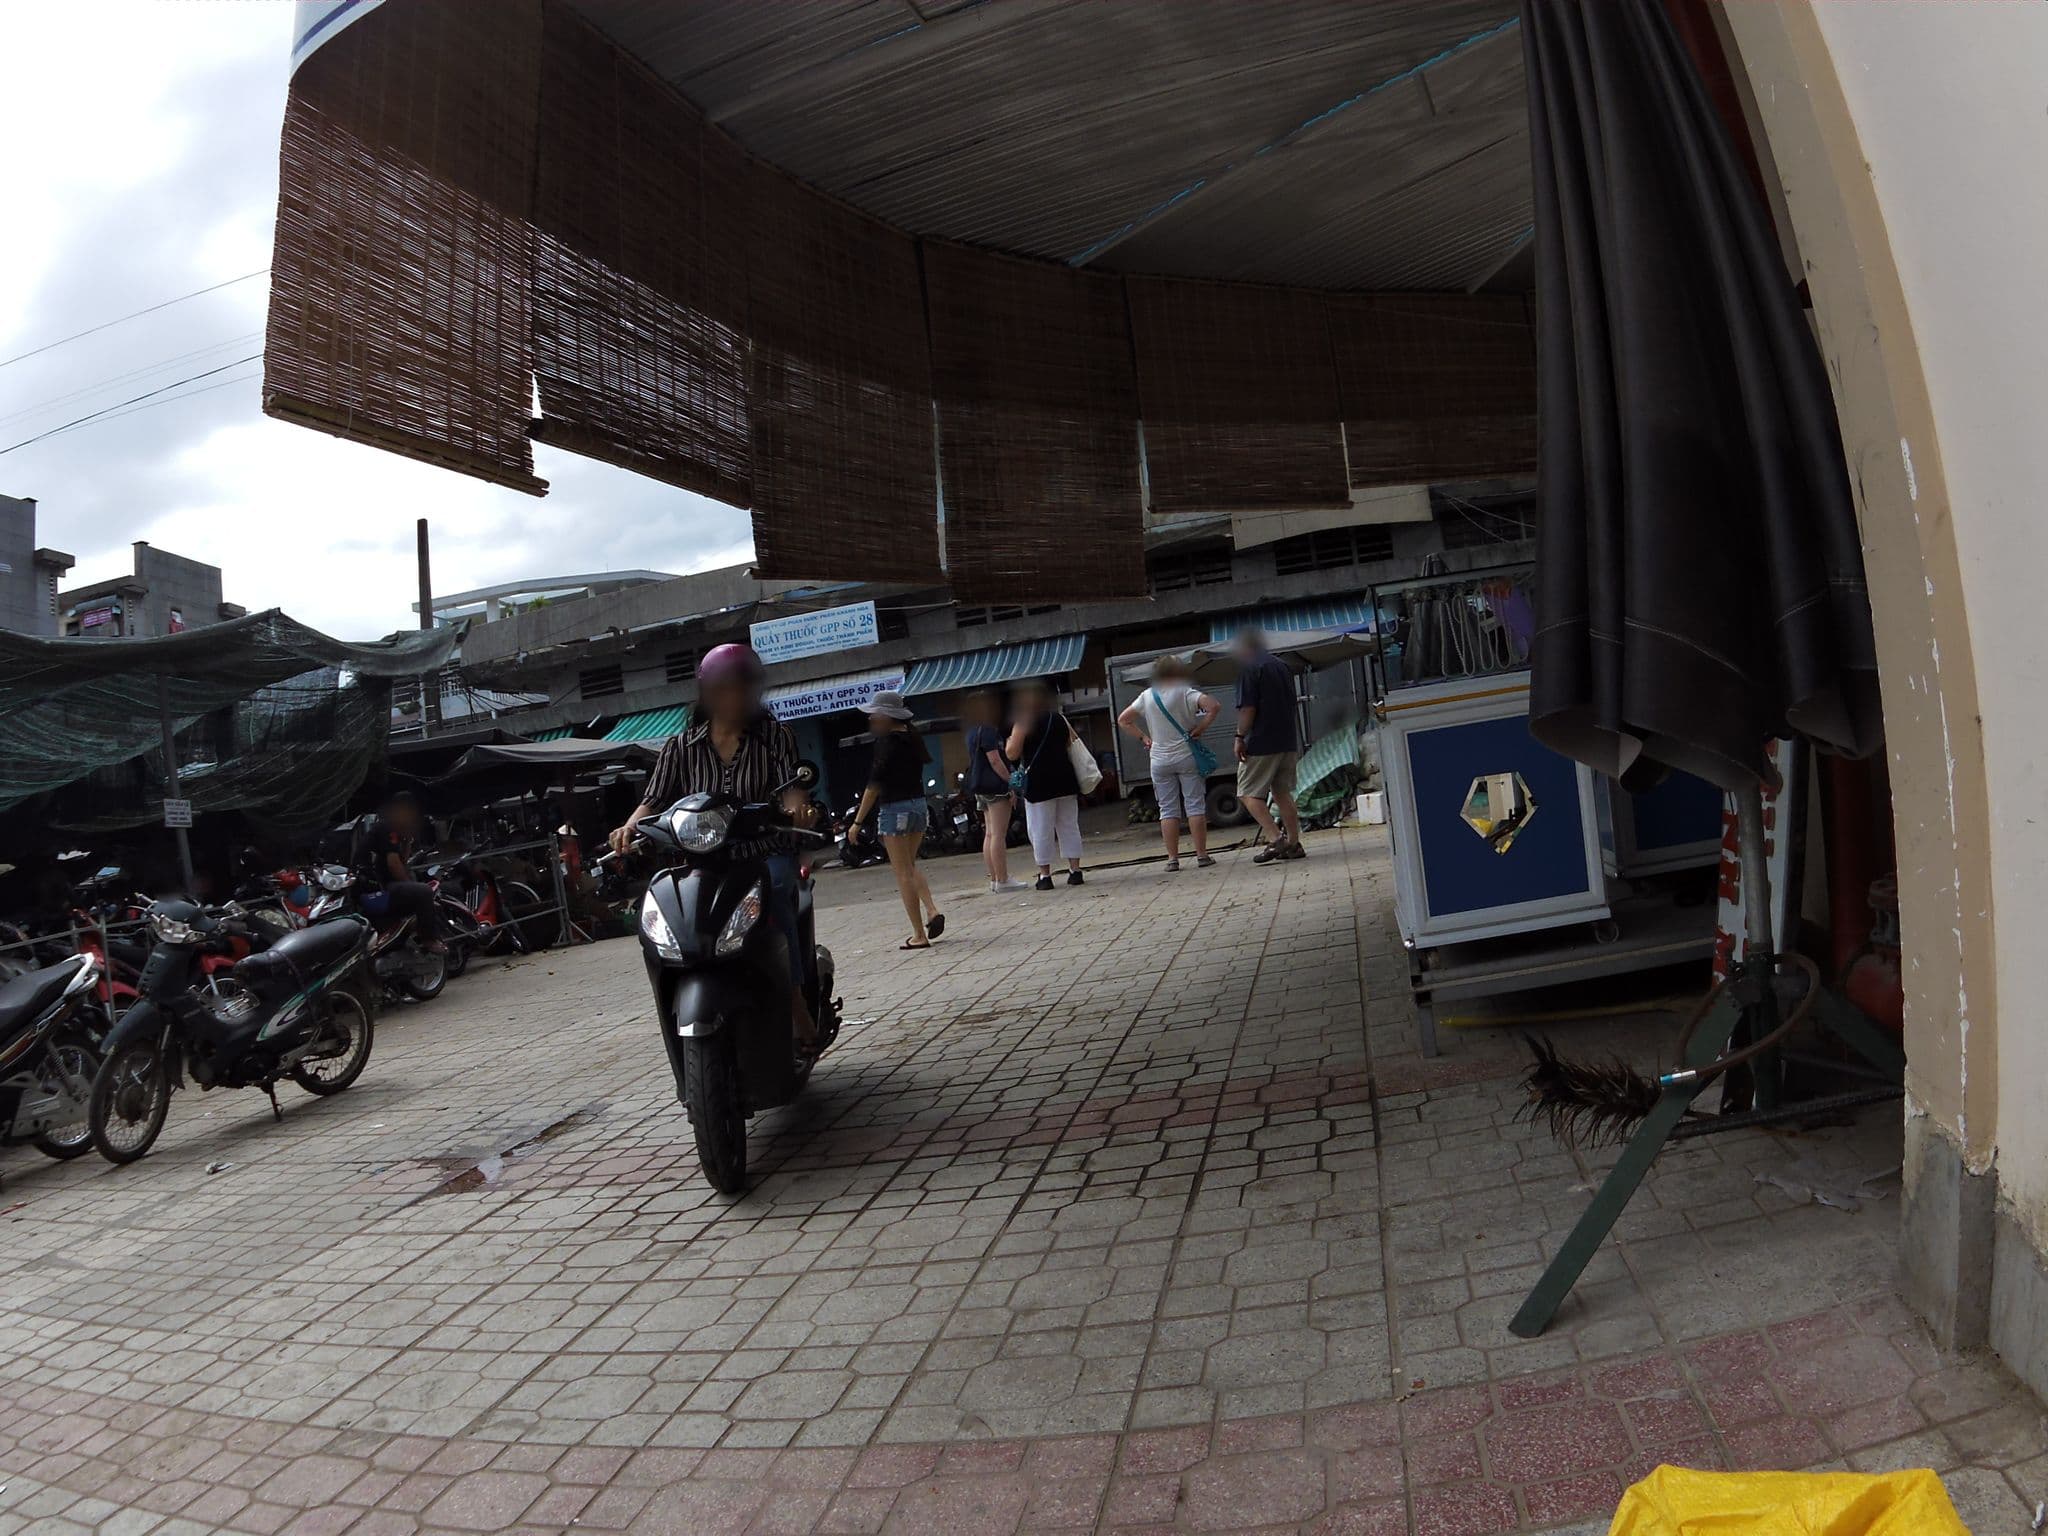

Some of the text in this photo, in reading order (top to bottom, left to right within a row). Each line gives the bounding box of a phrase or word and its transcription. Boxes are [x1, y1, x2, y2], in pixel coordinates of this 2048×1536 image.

[784, 622, 817, 641] THUỐC
[820, 621, 840, 634] GPP
[842, 613, 856, 630] SỐ
[859, 613, 874, 627] 28
[784, 693, 815, 710] THUỐC
[816, 690, 834, 702] TÂY
[837, 687, 855, 699] GPP
[858, 682, 871, 695] SỐ
[873, 682, 886, 692] 28
[777, 703, 821, 720] PHARMACI
